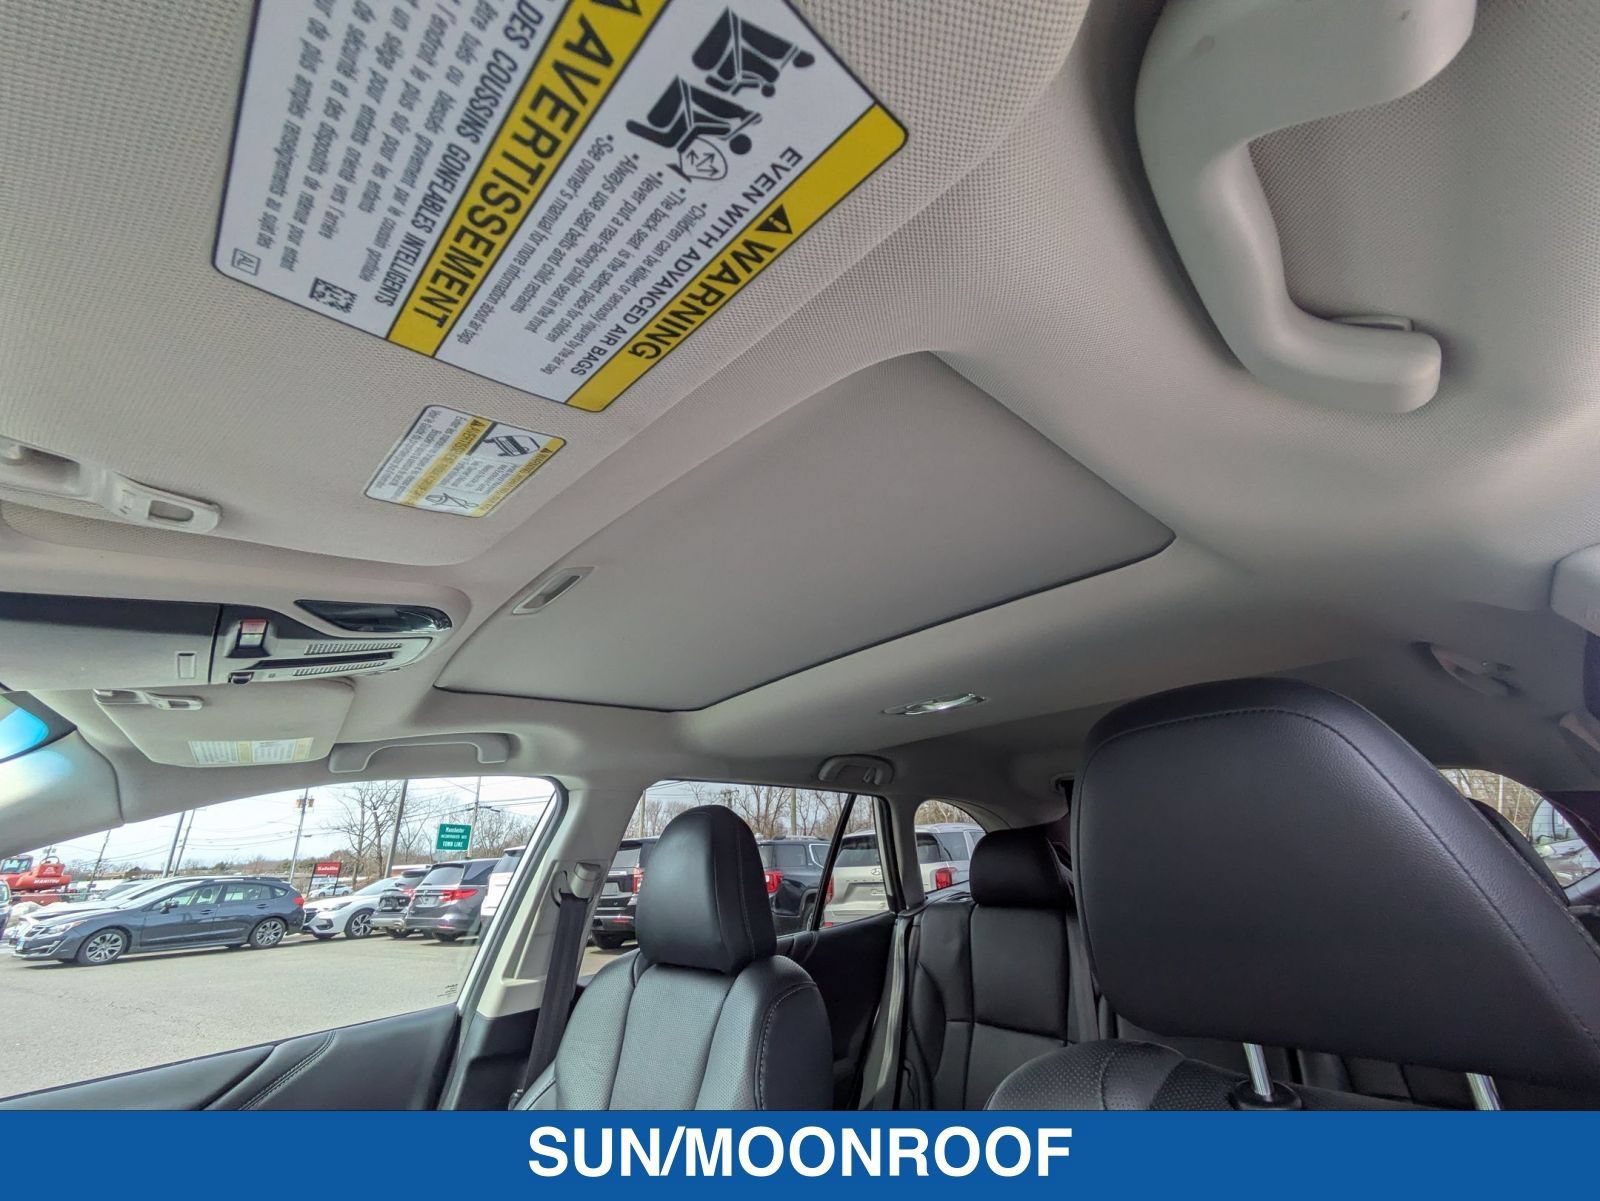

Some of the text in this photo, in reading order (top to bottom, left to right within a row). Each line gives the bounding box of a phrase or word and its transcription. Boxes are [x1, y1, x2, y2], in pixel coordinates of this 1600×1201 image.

[307, 17, 330, 40] de
[352, 0, 376, 23] de
[390, 6, 410, 31] un
[298, 38, 324, 74] plus
[336, 23, 367, 82] sécurité
[374, 31, 402, 70] siège
[454, 31, 482, 65] tués
[330, 79, 349, 98] et
[366, 67, 388, 104] pour
[410, 65, 431, 82] le
[445, 65, 464, 86] ou
[287, 74, 312, 119] amples
[323, 96, 346, 121] des
[398, 78, 421, 111] plus
[424, 89, 456, 134] blessés
[350, 104, 376, 146] enfants
[390, 111, 410, 135] sûr
[269, 119, 301, 197] renseignements
[307, 121, 338, 175] dispositifs
[374, 0, 544, 306] DES COUSSINS GONFLABLES INTELLIGENTS
[379, 131, 400, 162] pour
[400, 132, 433, 188] gravement
[338, 146, 361, 184] orienté
[371, 162, 392, 179] les
[413, 13, 614, 328] AVERTISSEMENT
[303, 175, 321, 190] de
[330, 184, 347, 204] vers
[358, 179, 381, 213] enfants
[392, 185, 410, 206] par
[265, 197, 281, 211] au
[293, 191, 314, 224] retenue
[387, 206, 404, 216] le
[287, 222, 304, 246] pour
[373, 217, 396, 249] coussin
[456, 137, 614, 344] See owner's manual for more information about air bags
[510, 155, 638, 313] Always use seat belts and child restraints
[236, 253, 254, 268] AL
[358, 247, 382, 282] gonflable
[524, 173, 663, 333] Never put a rear-facing child seat in the front
[545, 191, 686, 342] The back seat is the safest place for children
[570, 146, 803, 375] EVEN WITH ADVANCED AIR BAGS
[540, 205, 706, 374] Children can be killed or seriously injured by the air bag
[628, 239, 776, 359] WARNING
